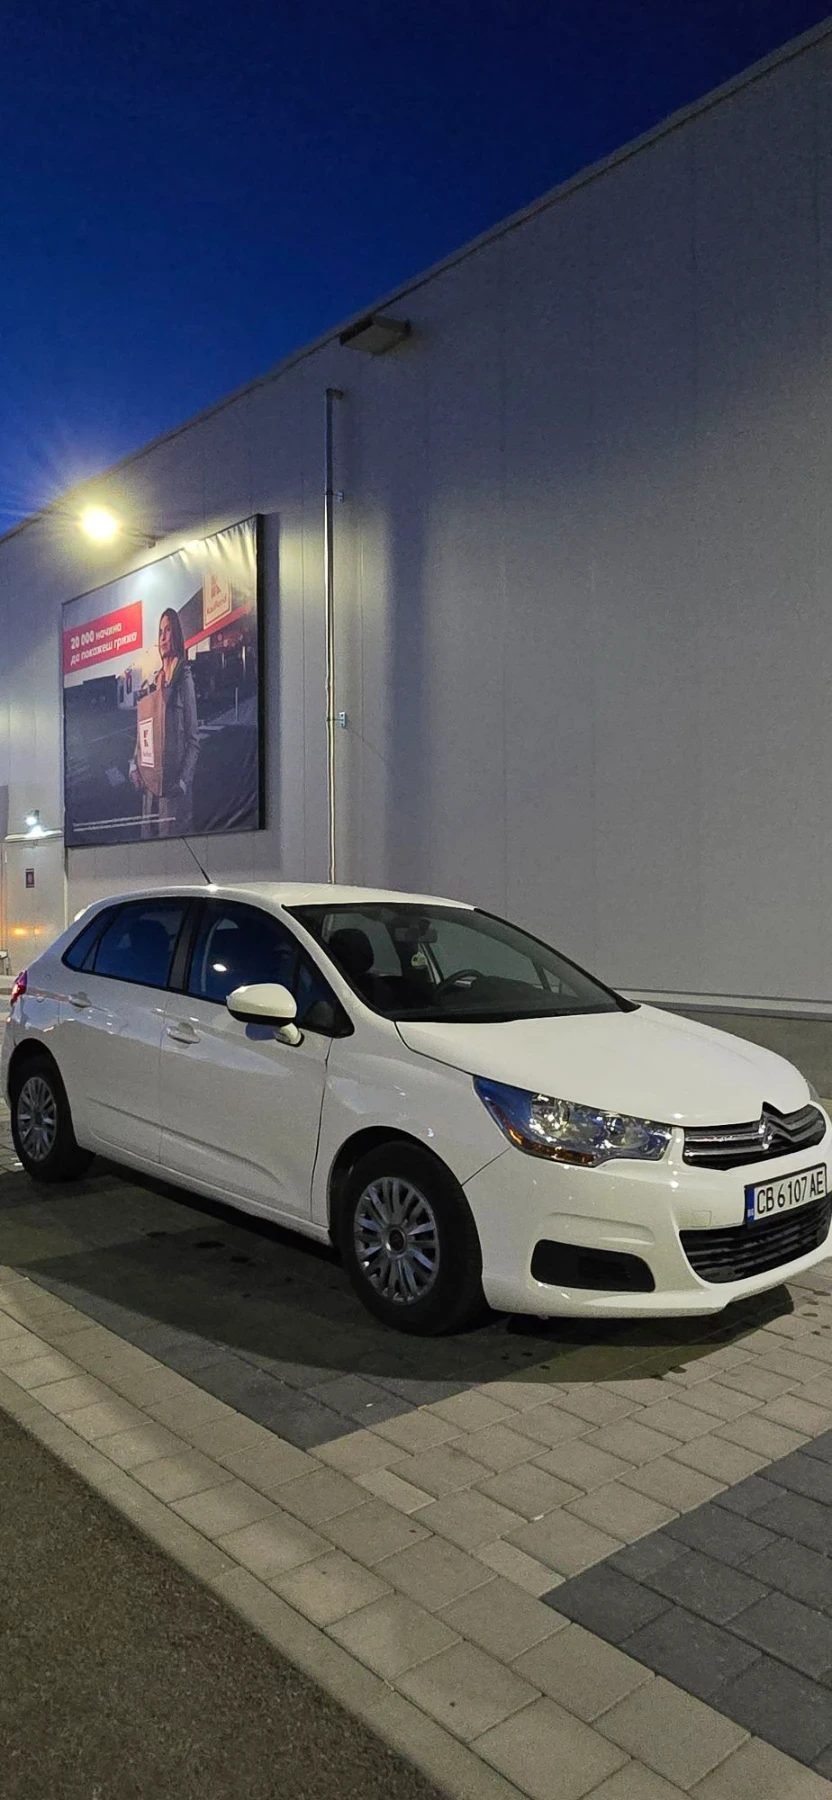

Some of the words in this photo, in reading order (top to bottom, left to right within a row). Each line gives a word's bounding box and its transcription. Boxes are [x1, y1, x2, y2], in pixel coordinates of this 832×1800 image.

[70, 636, 80, 649] 20
[81, 630, 95, 646] 000
[96, 622, 122, 641] начина
[70, 653, 80, 666] да
[81, 641, 113, 660] покажеш
[114, 631, 137, 651] грижа
[757, 1186, 775, 1214] CB
[777, 1176, 808, 1208] 6107
[810, 1170, 824, 1198] AE
